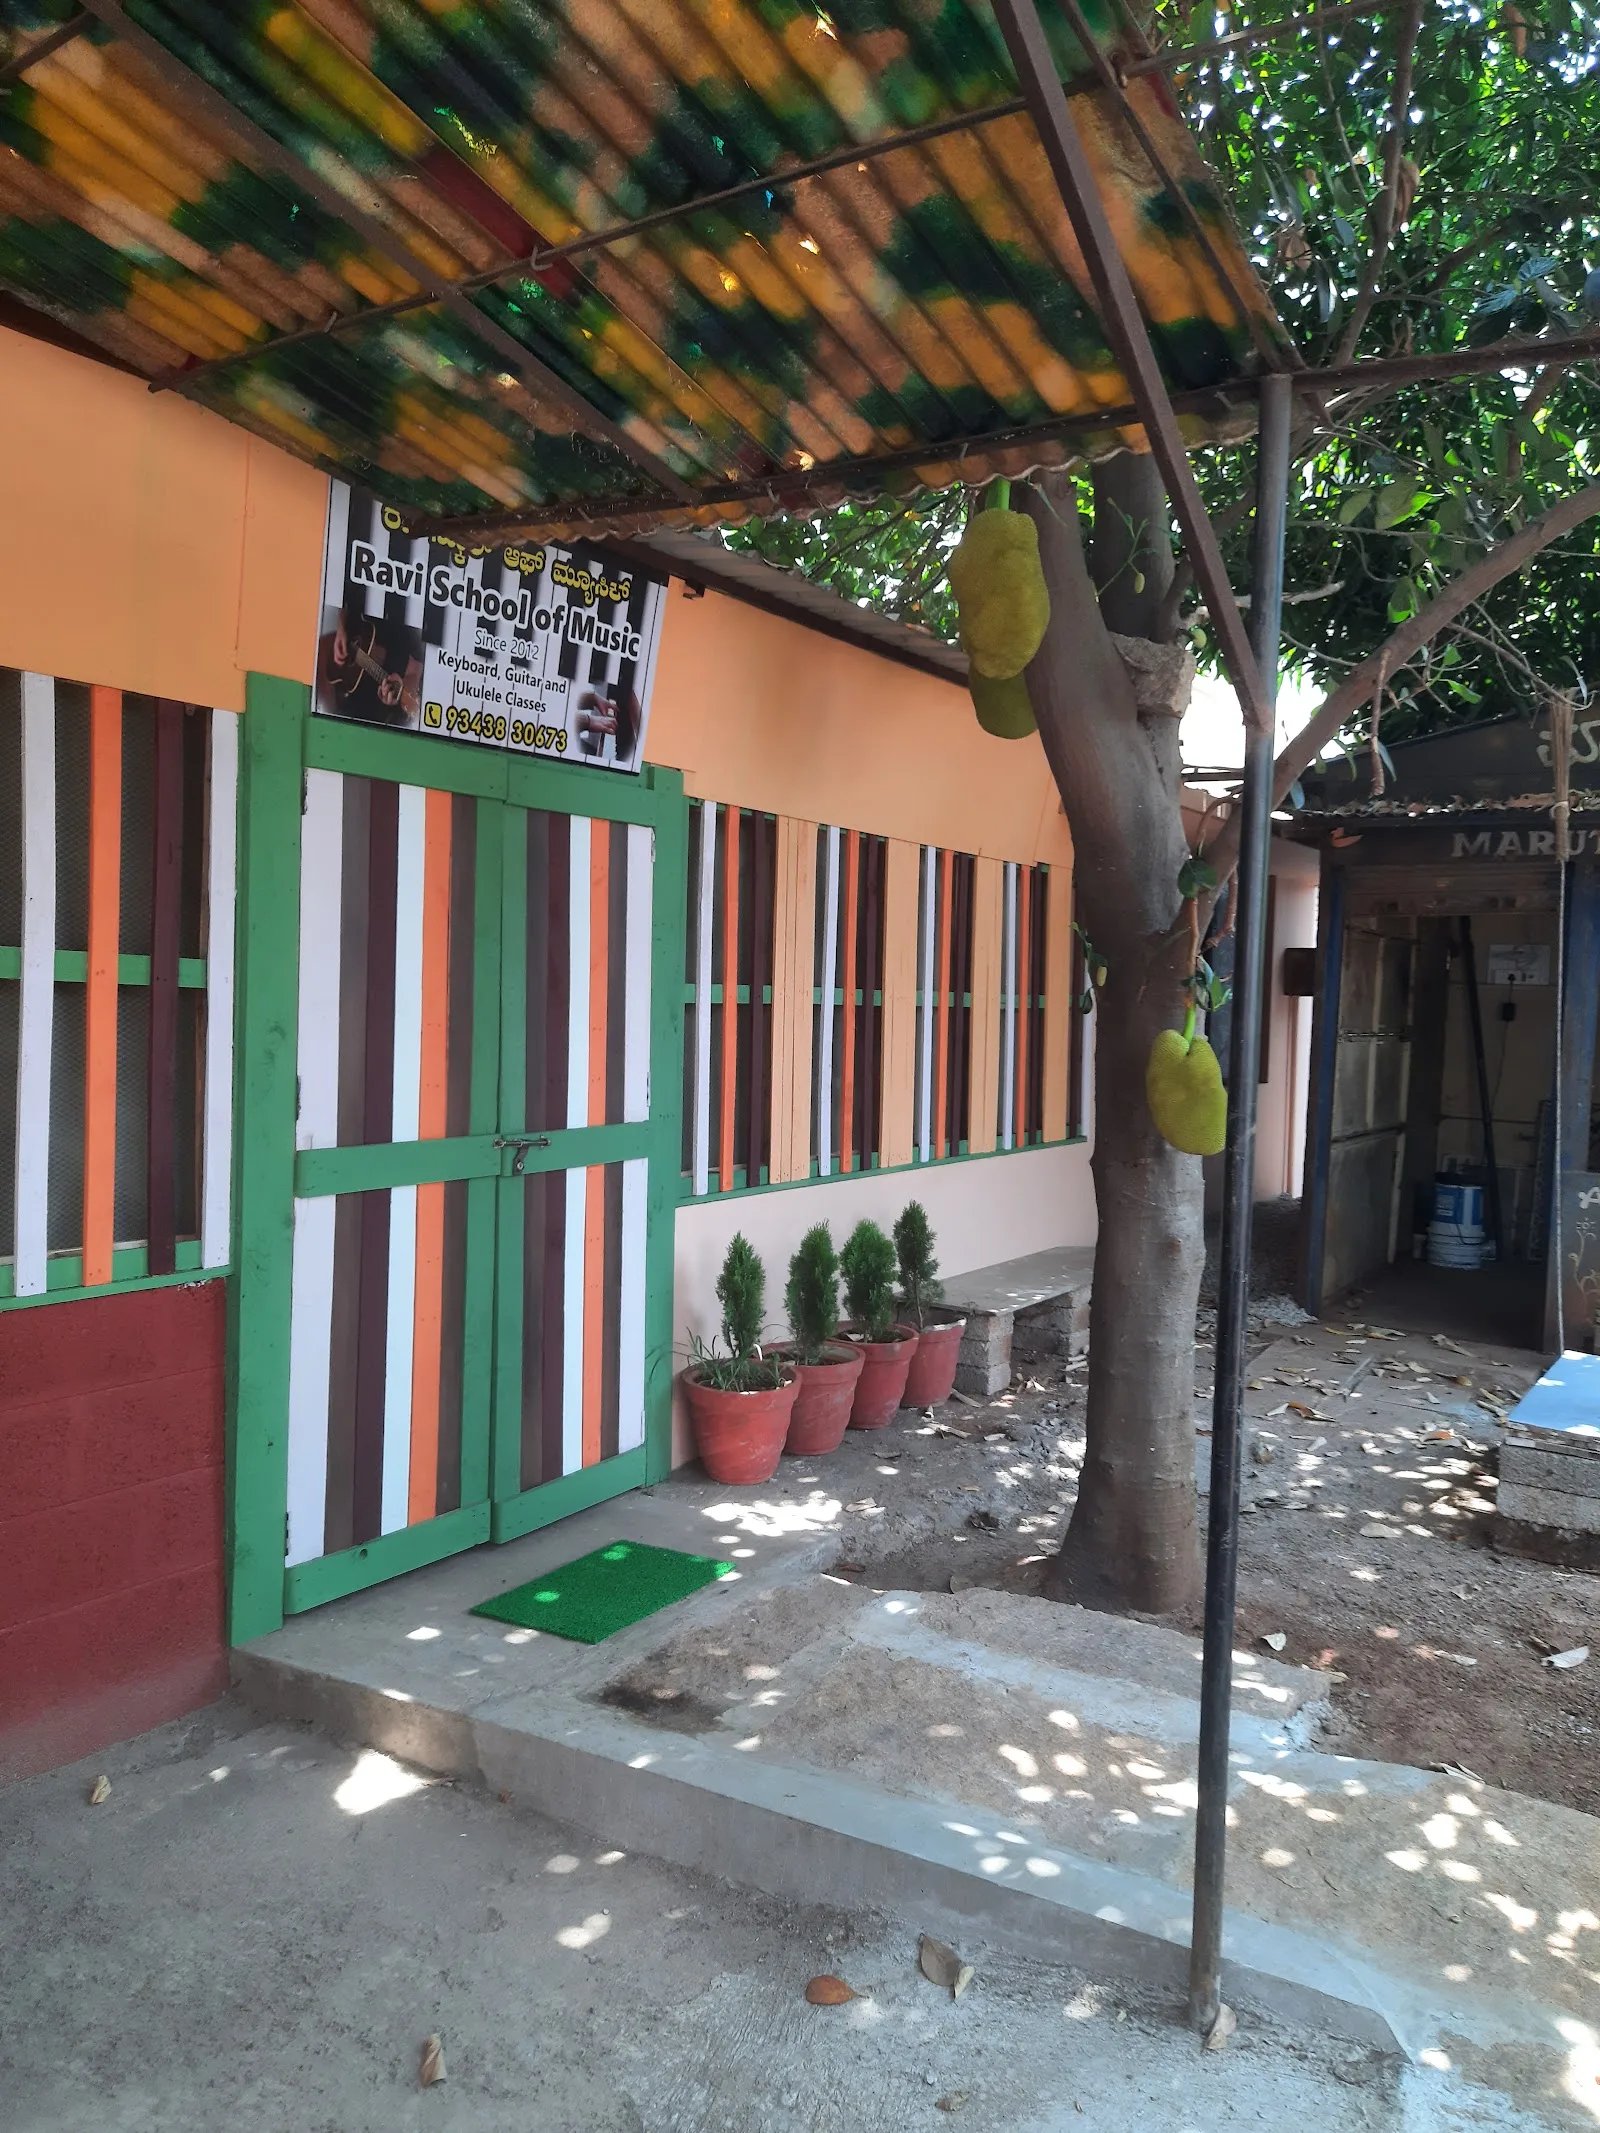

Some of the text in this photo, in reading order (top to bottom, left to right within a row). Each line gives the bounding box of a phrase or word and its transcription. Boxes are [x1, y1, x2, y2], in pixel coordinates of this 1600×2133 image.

[354, 545, 424, 595] Ravi
[432, 570, 529, 628] School
[534, 604, 566, 635] of
[570, 611, 640, 657] Music
[474, 630, 540, 661] Since 2012
[438, 650, 567, 694] Keyboard, Guitar and
[456, 680, 547, 713] Ukulele Classes
[446, 706, 568, 752] 93438 30673
